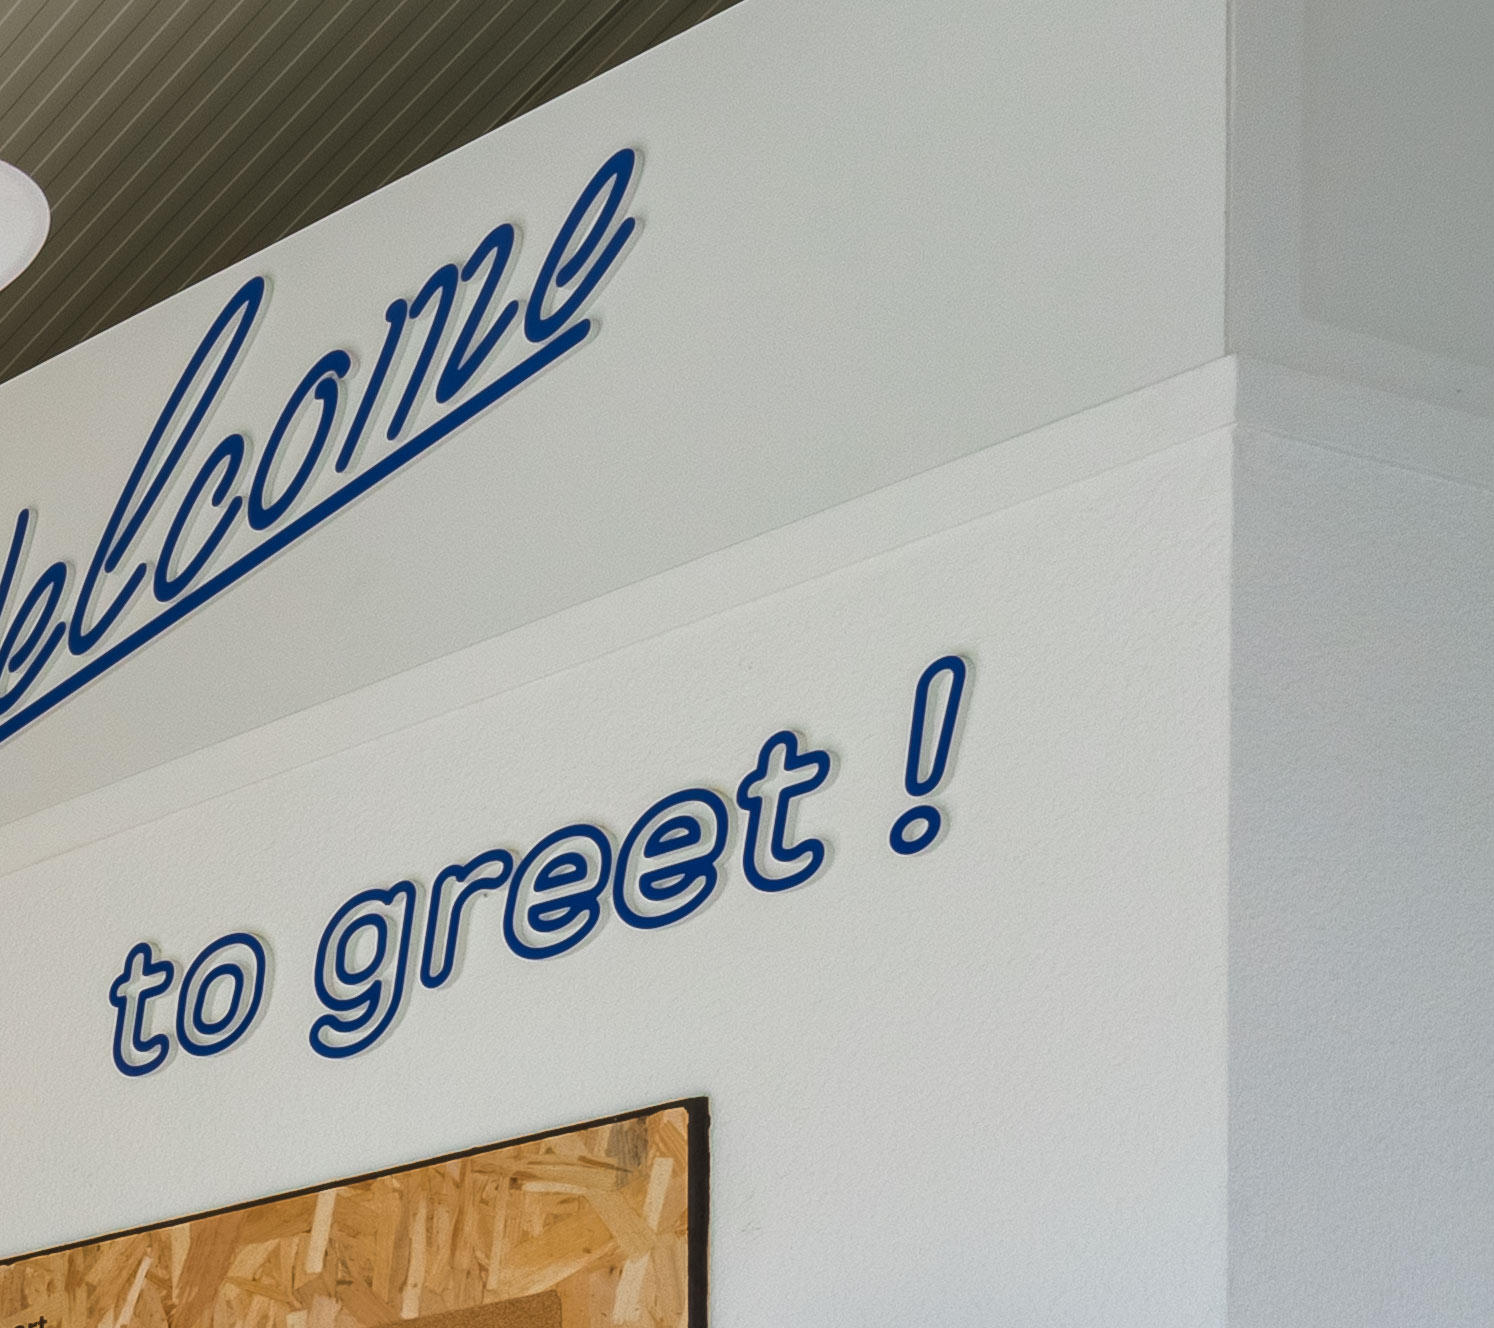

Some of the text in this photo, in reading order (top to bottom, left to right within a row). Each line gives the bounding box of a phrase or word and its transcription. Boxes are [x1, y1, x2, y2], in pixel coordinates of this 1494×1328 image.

[110, 655, 968, 1077] to greet !
